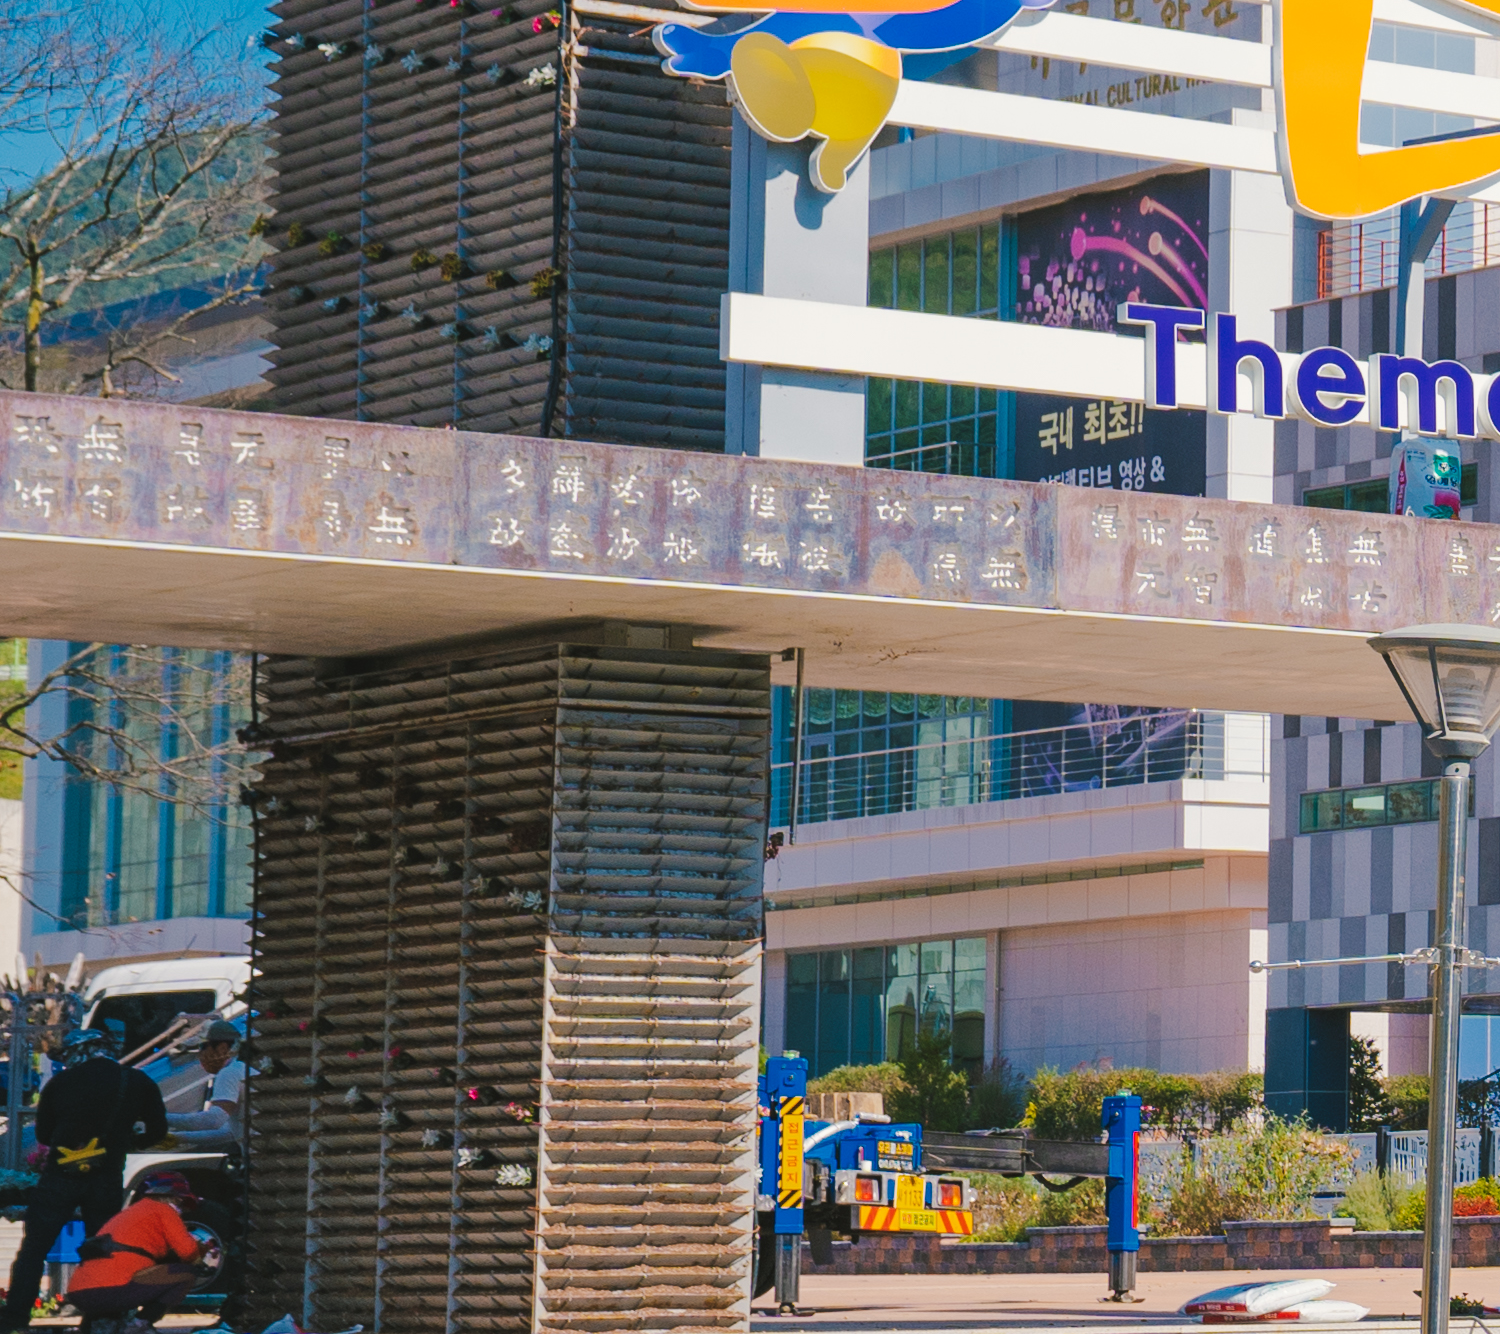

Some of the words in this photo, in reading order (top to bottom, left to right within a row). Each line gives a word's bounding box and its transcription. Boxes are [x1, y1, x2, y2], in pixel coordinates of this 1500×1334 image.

[1038, 411, 1074, 455] 국내
[1083, 400, 1144, 445] 최초!!
[1118, 456, 1147, 491] 영상
[1150, 455, 1166, 482] &
[786, 1122, 799, 1184] 접근금지
